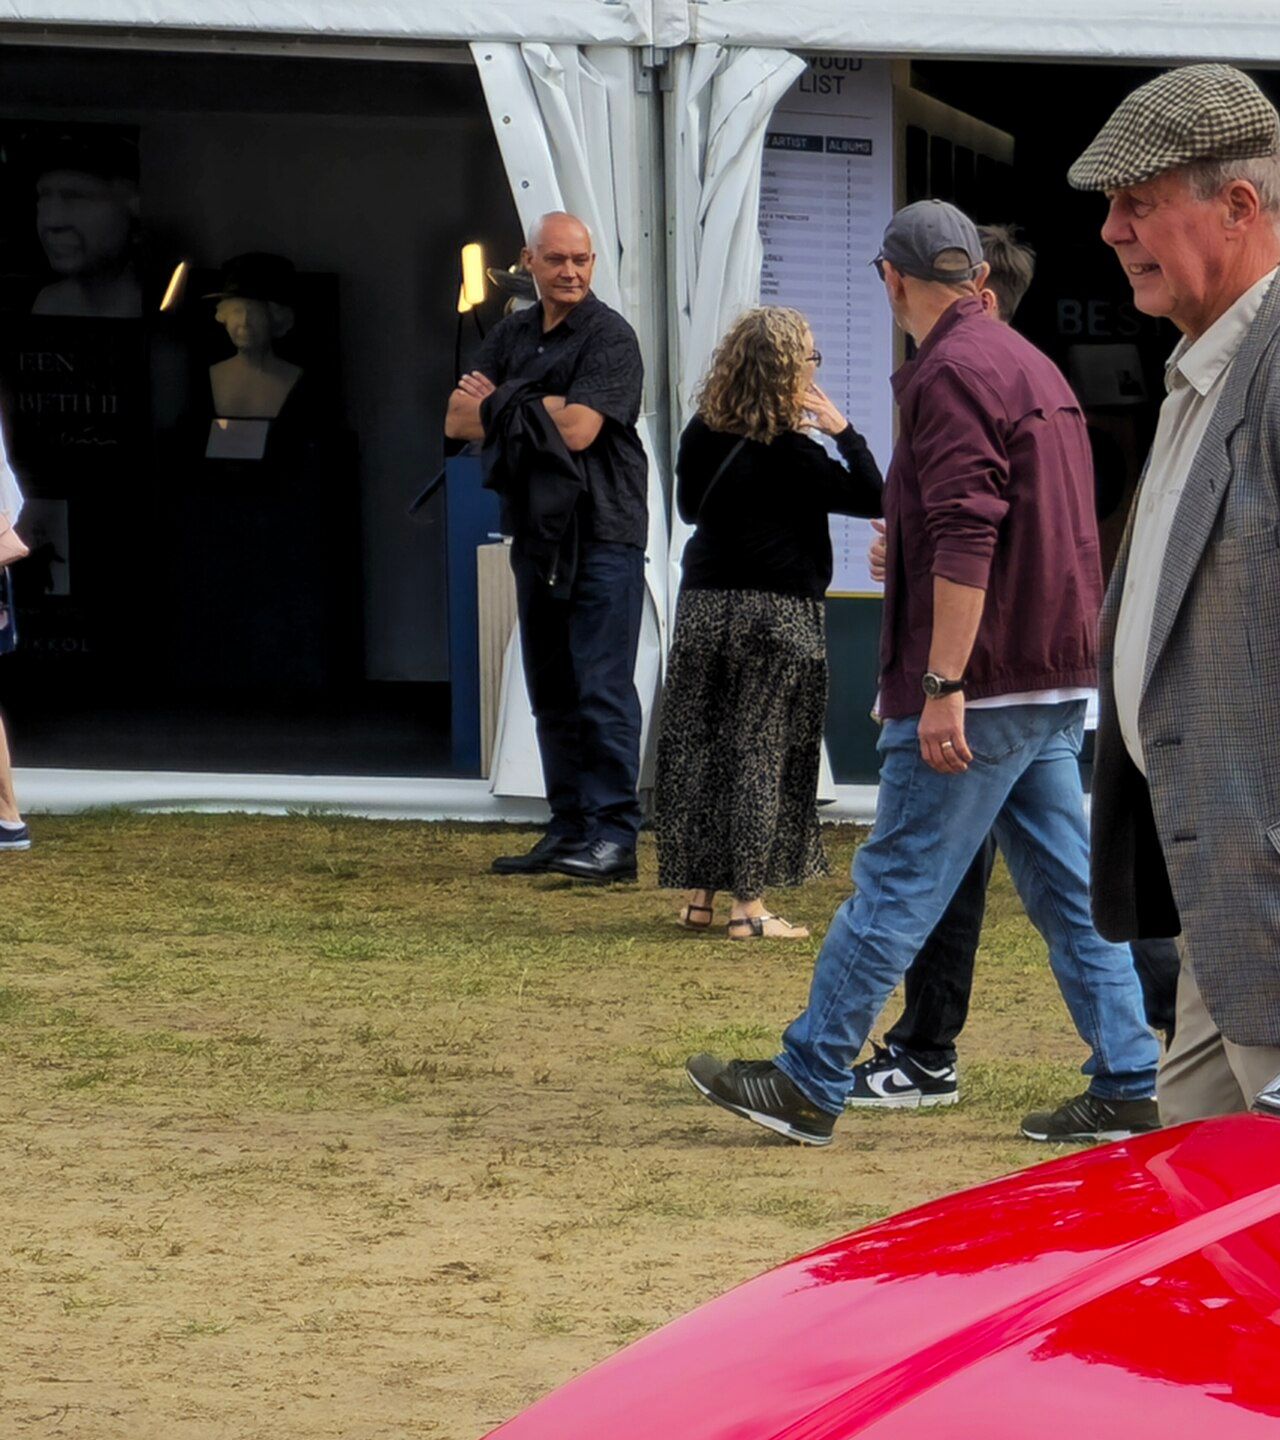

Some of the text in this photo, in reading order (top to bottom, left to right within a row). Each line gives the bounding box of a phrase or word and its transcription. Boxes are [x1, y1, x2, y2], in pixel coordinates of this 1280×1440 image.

[771, 136, 807, 148] ARTIST
[828, 139, 870, 152] ALBUMS
[19, 394, 95, 415] BETH
